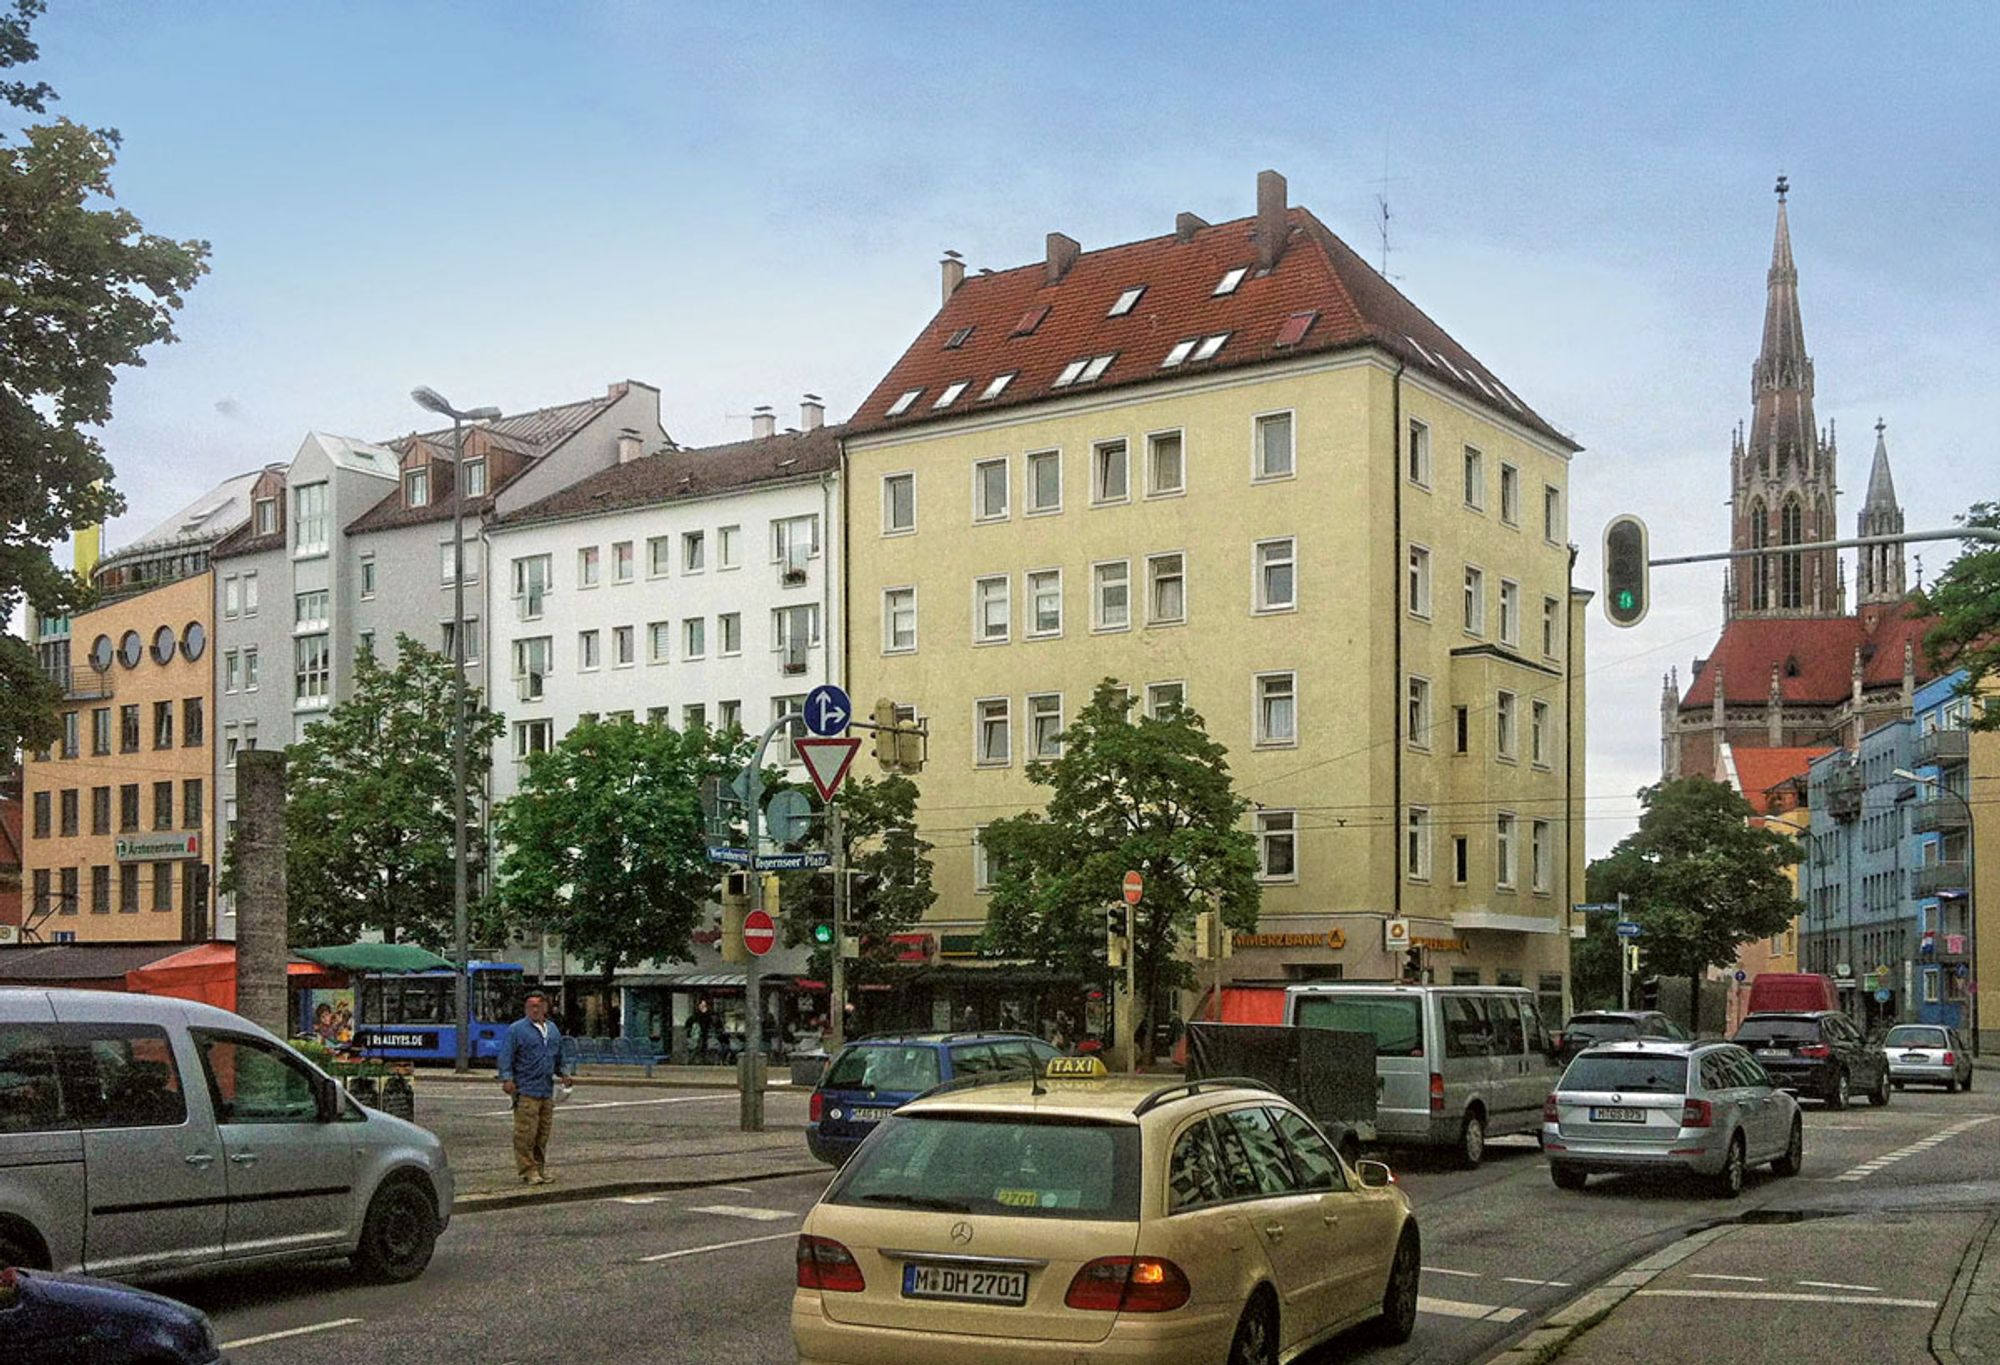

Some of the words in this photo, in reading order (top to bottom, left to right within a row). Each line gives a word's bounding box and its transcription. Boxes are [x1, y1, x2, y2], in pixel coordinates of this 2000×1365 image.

[755, 857, 801, 869] Tegernseer
[1234, 933, 1323, 947] MMERZBANK
[1055, 1059, 1092, 1072] TAXI
[915, 1270, 928, 1291] M
[942, 1271, 968, 1294] DH
[972, 1273, 1021, 1297] 2701
